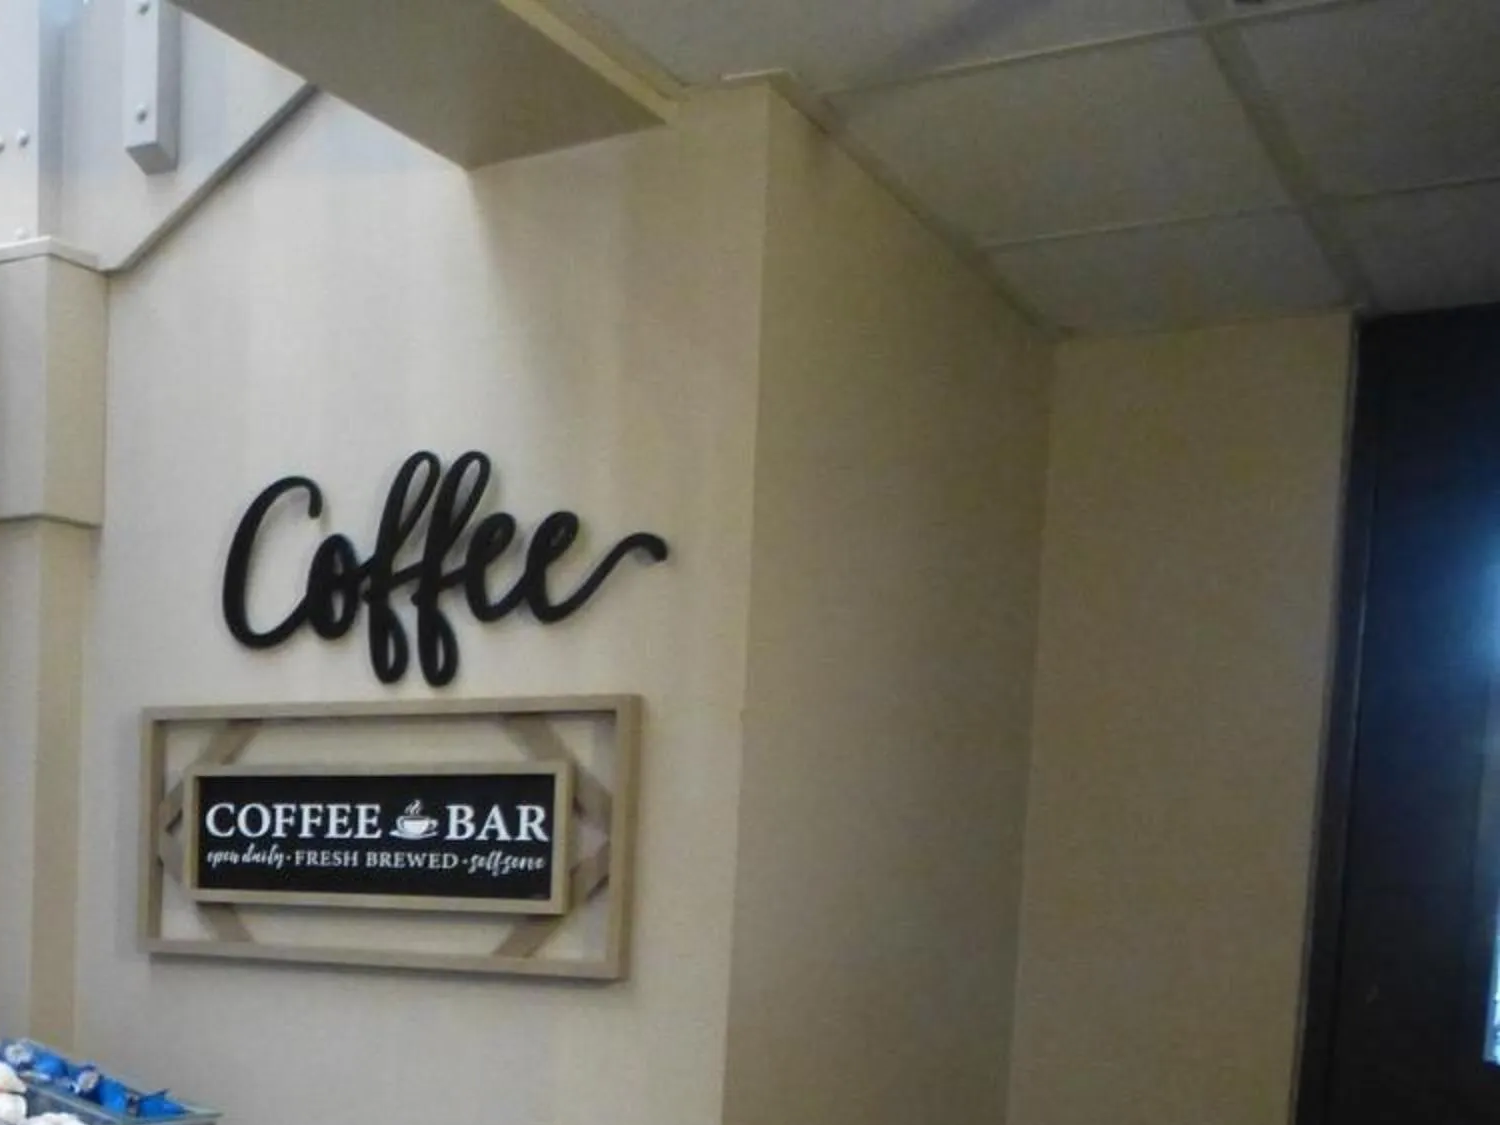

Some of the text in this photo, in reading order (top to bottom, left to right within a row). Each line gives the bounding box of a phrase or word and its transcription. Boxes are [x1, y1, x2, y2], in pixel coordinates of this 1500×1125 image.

[222, 450, 668, 687] Coffee
[205, 803, 549, 842] COFFEE BAR
[206, 850, 240, 869] open
[242, 842, 285, 870] daily
[295, 851, 359, 867] FRESH
[365, 851, 460, 869] BREWED
